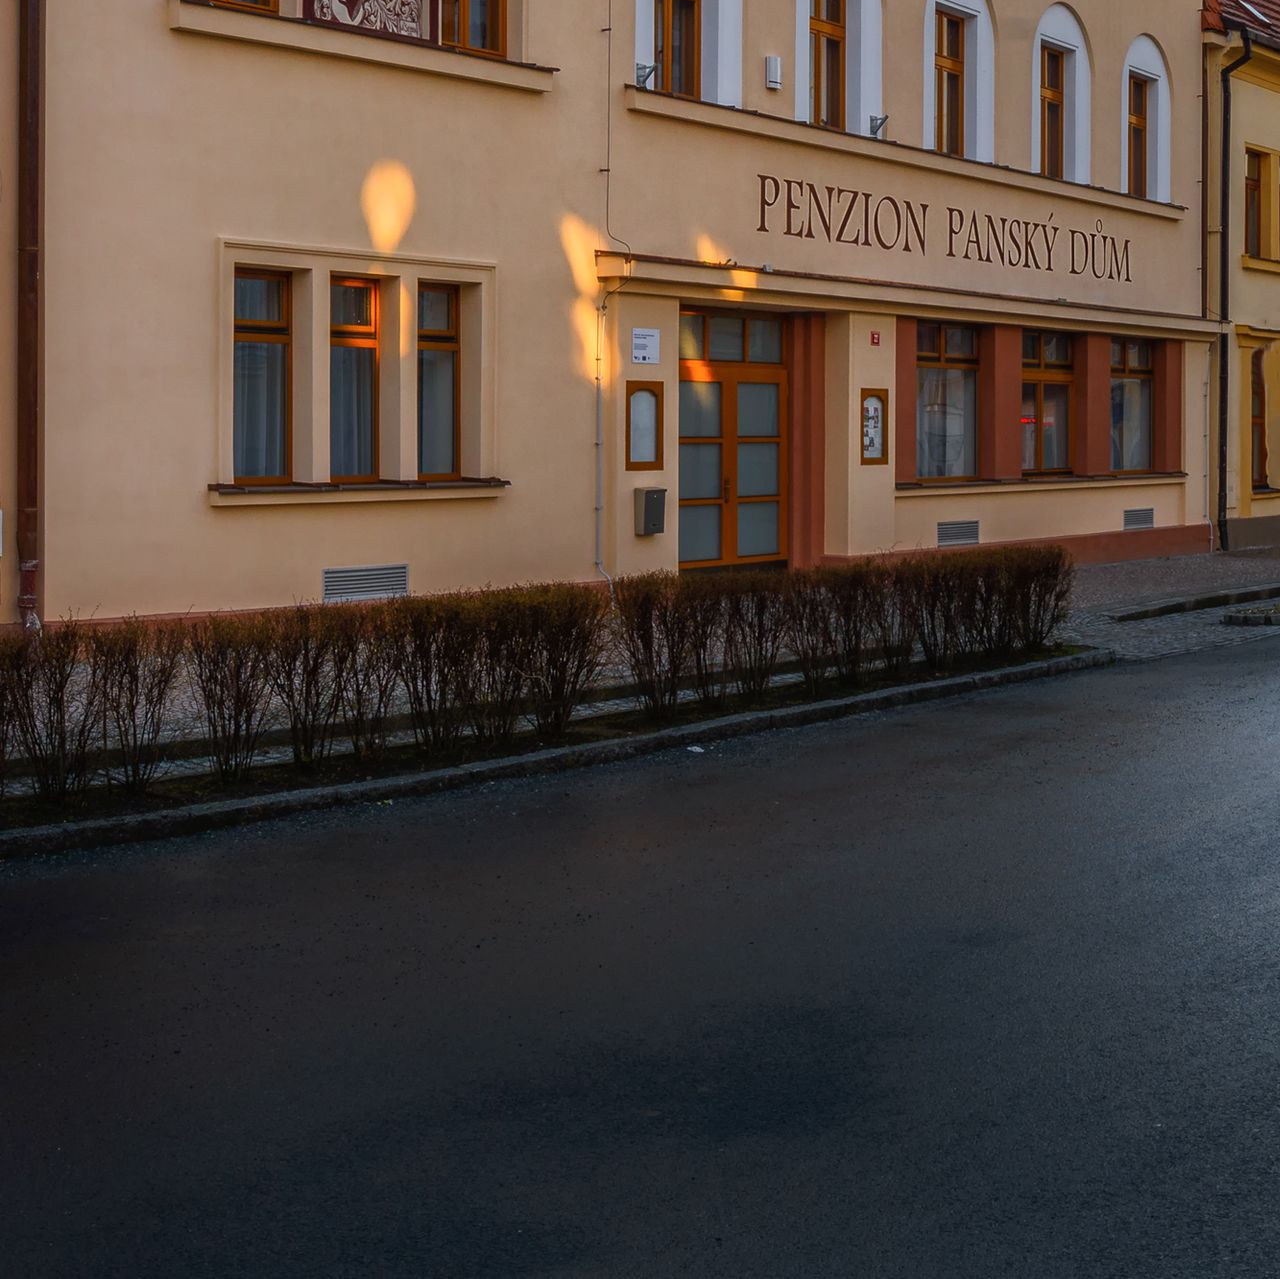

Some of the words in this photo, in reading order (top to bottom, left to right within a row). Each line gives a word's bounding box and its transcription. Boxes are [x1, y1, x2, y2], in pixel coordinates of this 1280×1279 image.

[756, 174, 929, 256] PENZION
[946, 207, 1060, 272] PANSKÝ
[1069, 219, 1132, 283] DŮM
